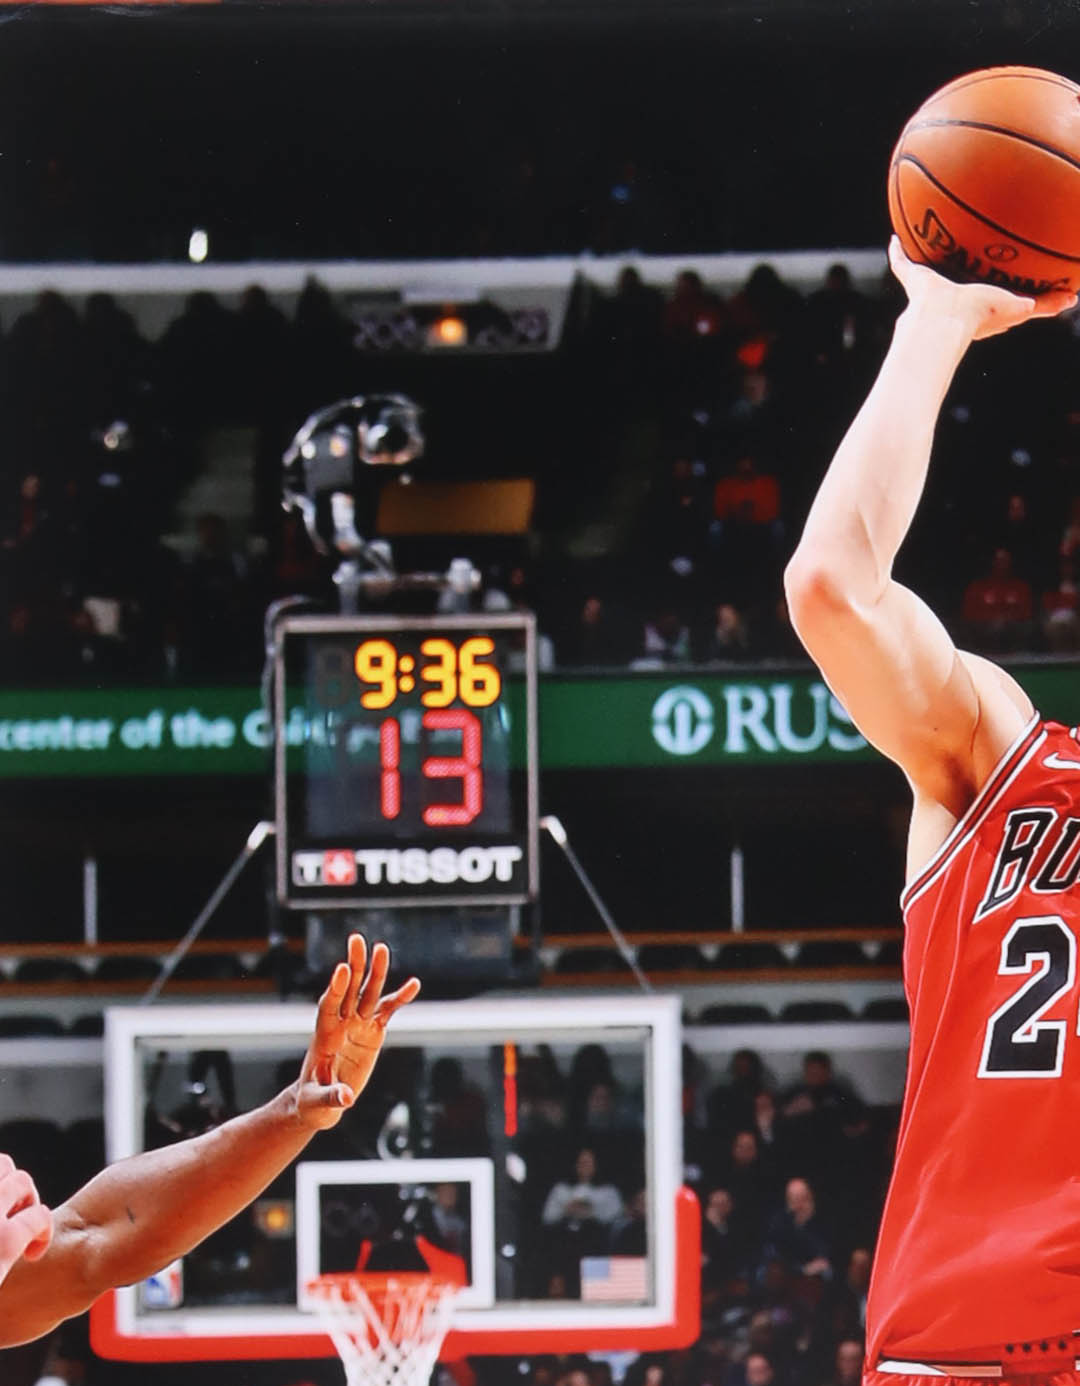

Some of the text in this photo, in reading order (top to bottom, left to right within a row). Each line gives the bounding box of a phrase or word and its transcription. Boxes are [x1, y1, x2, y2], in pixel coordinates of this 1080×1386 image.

[354, 637, 501, 709] 9:36
[120, 708, 164, 750] of
[170, 707, 236, 750] the
[380, 708, 484, 829] 13
[356, 846, 523, 885] TISSOT
